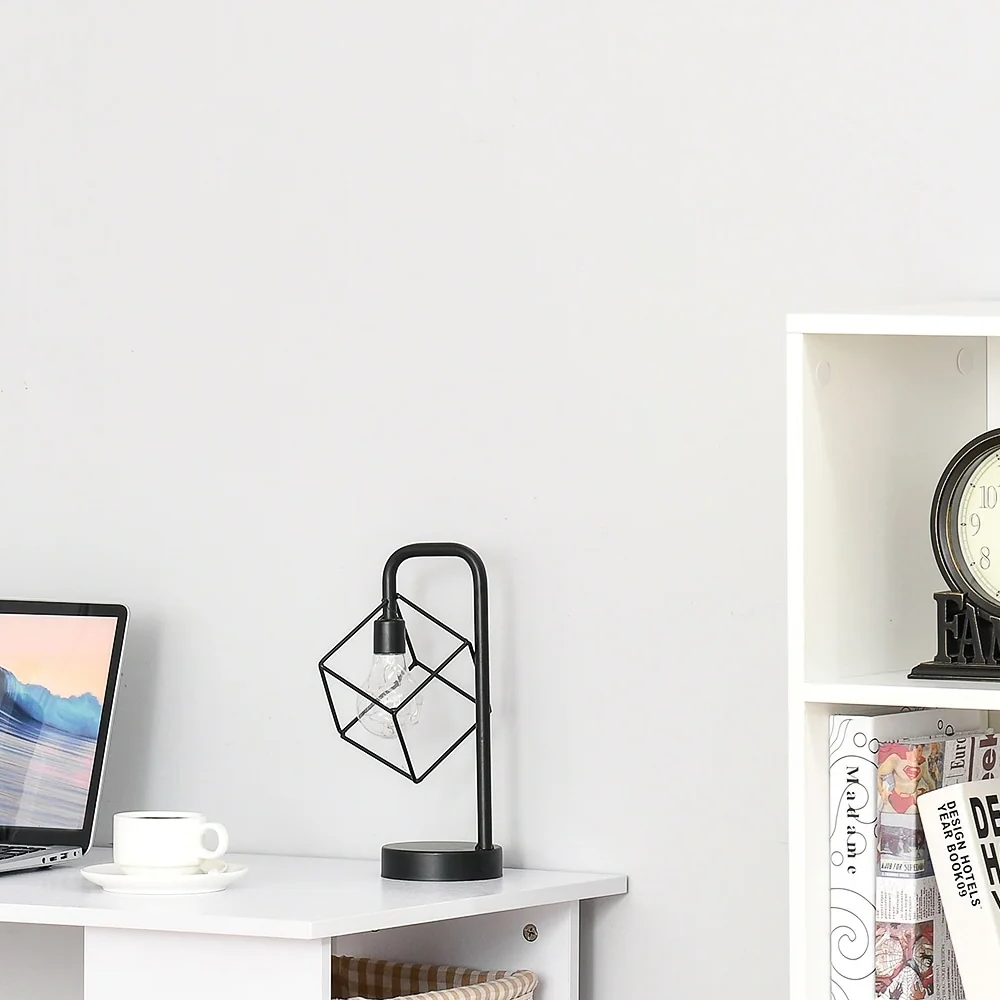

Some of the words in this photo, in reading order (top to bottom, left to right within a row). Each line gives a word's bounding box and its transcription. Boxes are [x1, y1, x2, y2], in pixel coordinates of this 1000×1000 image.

[979, 485, 998, 509] 10
[970, 513, 981, 537] 9
[980, 546, 991, 570] 8
[846, 766, 860, 875] Madame
[937, 803, 954, 840] YEAR
[946, 800, 967, 850] DESIGN
[960, 854, 981, 907] HOTELS
